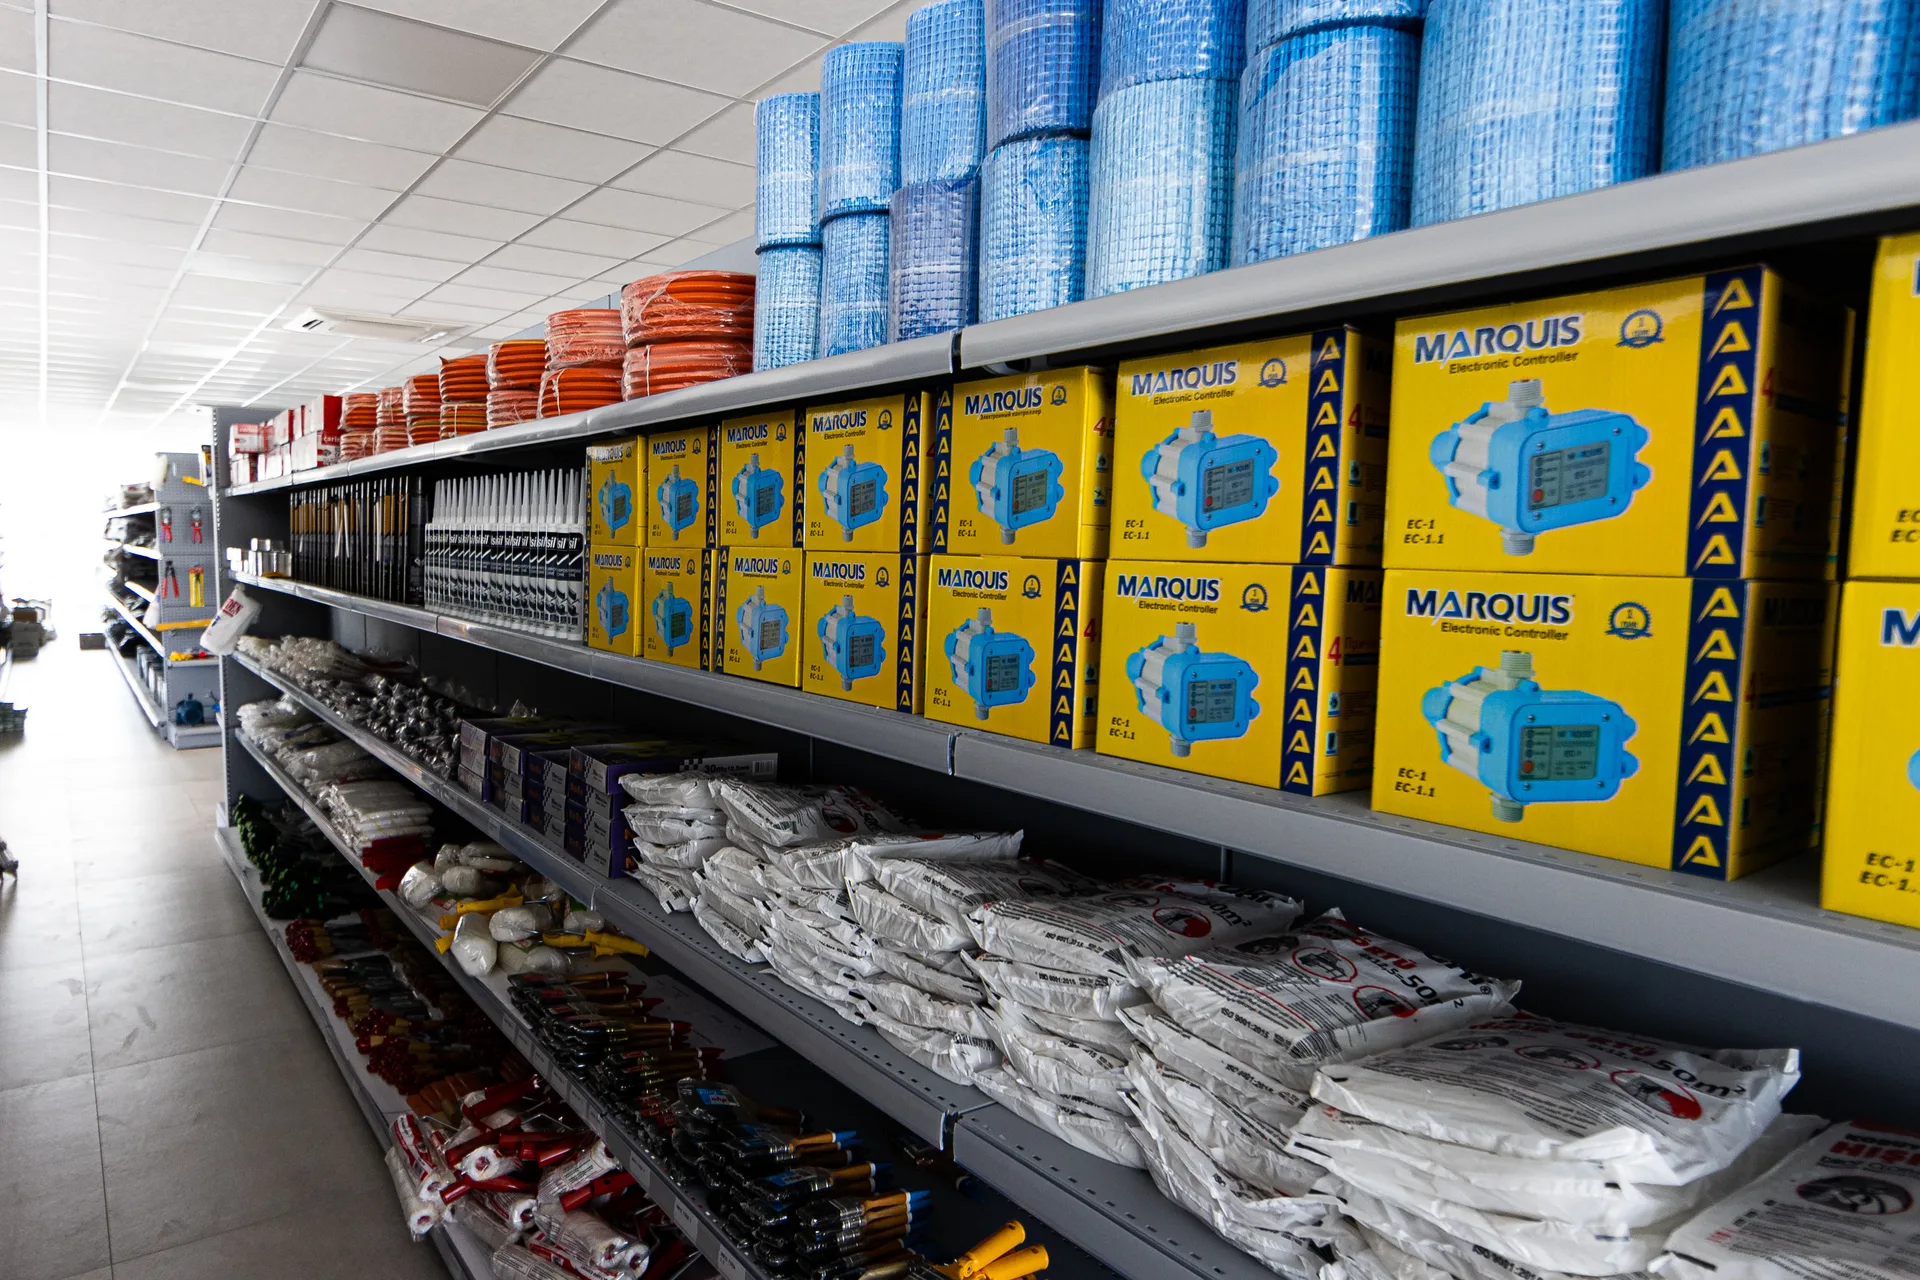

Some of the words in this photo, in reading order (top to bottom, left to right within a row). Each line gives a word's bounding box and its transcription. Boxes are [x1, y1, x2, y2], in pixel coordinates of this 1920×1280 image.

[1414, 313, 1580, 368] MARQUIS
[1449, 357, 1510, 375] Electronic
[1512, 349, 1579, 369] Controller
[1131, 360, 1238, 400] MARQUIS
[964, 386, 1043, 420] MARQUIS
[1153, 391, 1193, 406] Electronic
[1193, 389, 1235, 401] Controller
[812, 410, 867, 433] MARQUIS
[1348, 403, 1363, 435] 4
[727, 424, 768, 443] MARQUIS
[823, 431, 844, 441] Electronic
[844, 429, 866, 438] Controller
[652, 438, 687, 455] MARQUIS
[959, 519, 973, 528] EC-1
[1125, 519, 1144, 529] EC-1
[1406, 518, 1436, 530] EC-1
[957, 529, 977, 538] EC-1.1
[1123, 531, 1150, 541] EC-1.1
[1403, 532, 1445, 546] EC-1.1
[594, 553, 623, 567] MARQUIS
[648, 556, 681, 571] MARQUIS
[734, 558, 779, 574] MARQUIS
[812, 562, 866, 581] MARQUIS
[843, 581, 865, 589] Controller
[937, 568, 1009, 592] MARQUIS
[1116, 573, 1221, 603] MARQUIS
[952, 590, 980, 600] Electronic
[979, 592, 1007, 601] Controller
[1138, 601, 1176, 612] Electronic
[1177, 602, 1218, 614] Controller
[1406, 588, 1572, 625] MARQUIS
[1083, 618, 1097, 642] 4
[1441, 621, 1501, 636] Electronic
[1503, 624, 1569, 642] Controller
[1328, 636, 1342, 666] 4
[934, 688, 948, 697] EC-1
[932, 697, 951, 707] EC-1.1
[1111, 717, 1130, 727] EC-1
[1109, 728, 1136, 740] EC-1.1
[1398, 768, 1427, 781] EC-1
[1394, 782, 1436, 798] EC-1.1
[1865, 851, 1916, 873] EC-1
[1858, 870, 1920, 895] EC-1.
[1220, 1007, 1235, 1019] ISO
[1234, 1013, 1270, 1039] 9001:2015
[1472, 1244, 1490, 1259] ISO
